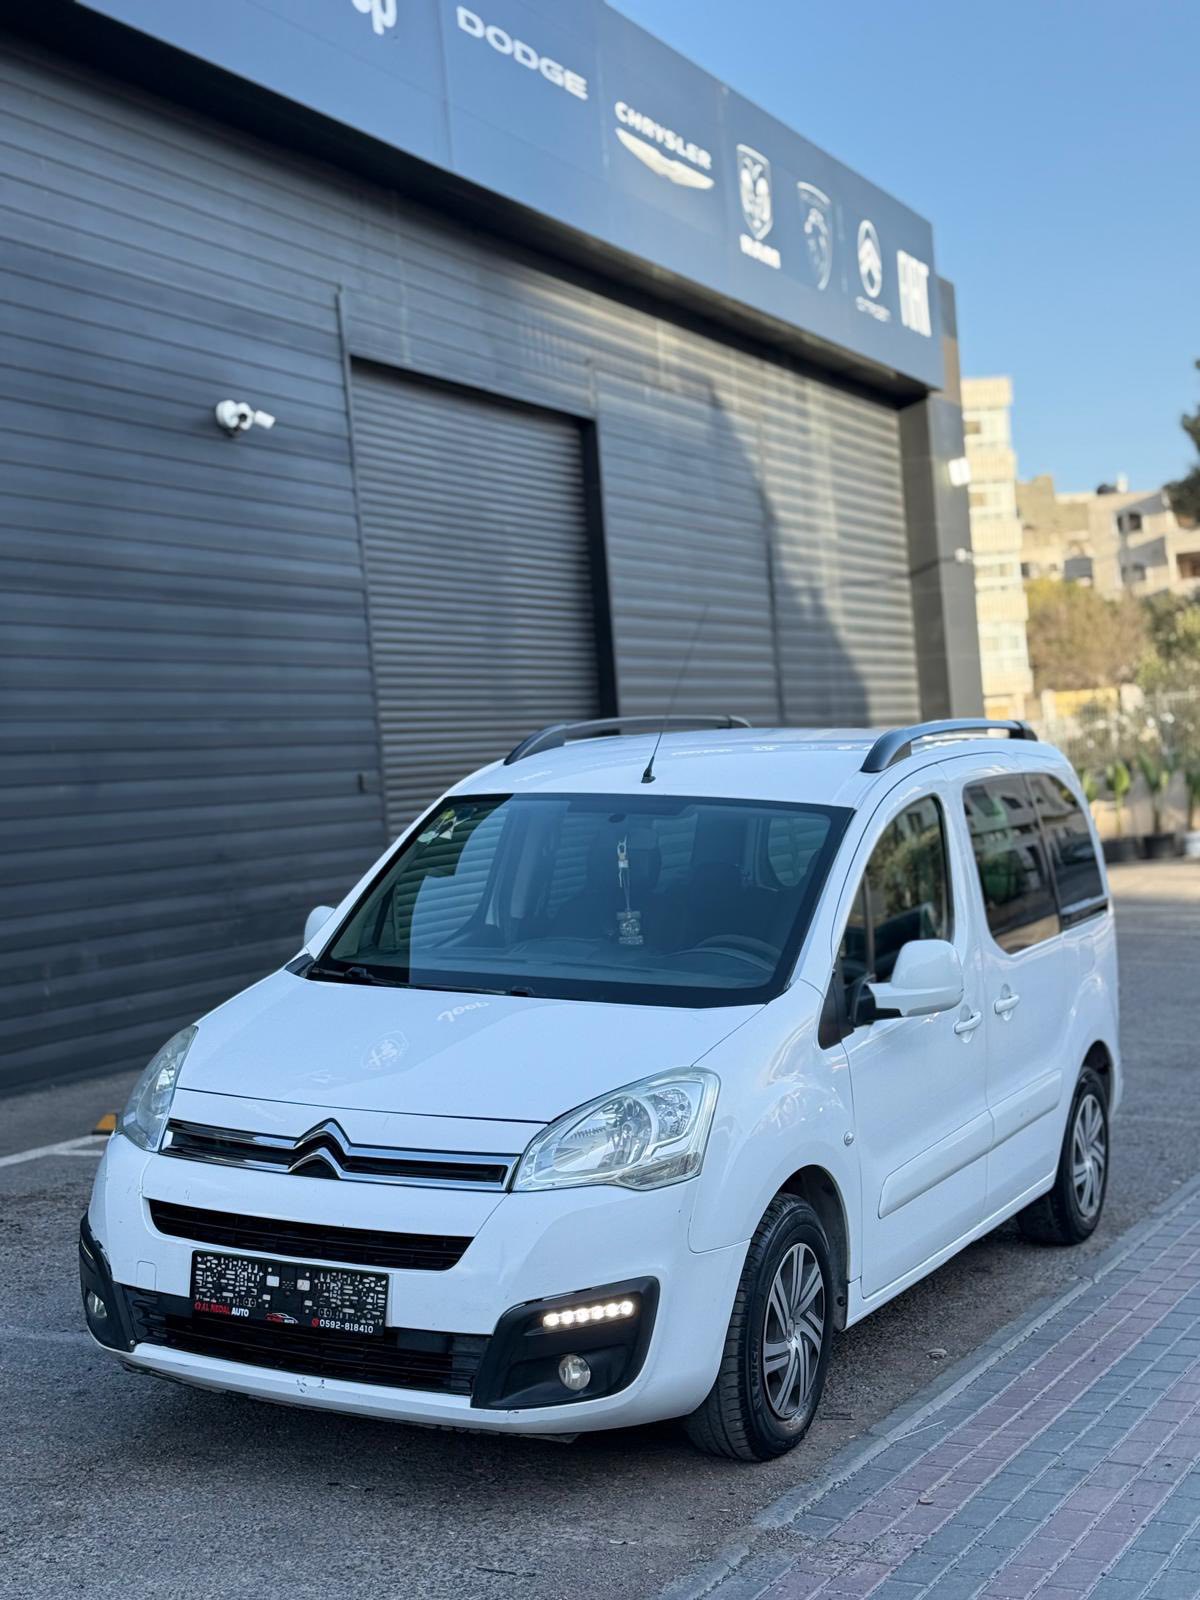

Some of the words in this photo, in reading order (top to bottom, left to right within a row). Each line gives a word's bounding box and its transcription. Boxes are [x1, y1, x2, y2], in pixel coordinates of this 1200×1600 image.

[456, 6, 588, 100] DODGE
[614, 101, 711, 170] CHRYSLER
[231, 1307, 249, 1317] AUTO
[319, 1319, 374, 1334] 0592-818410
